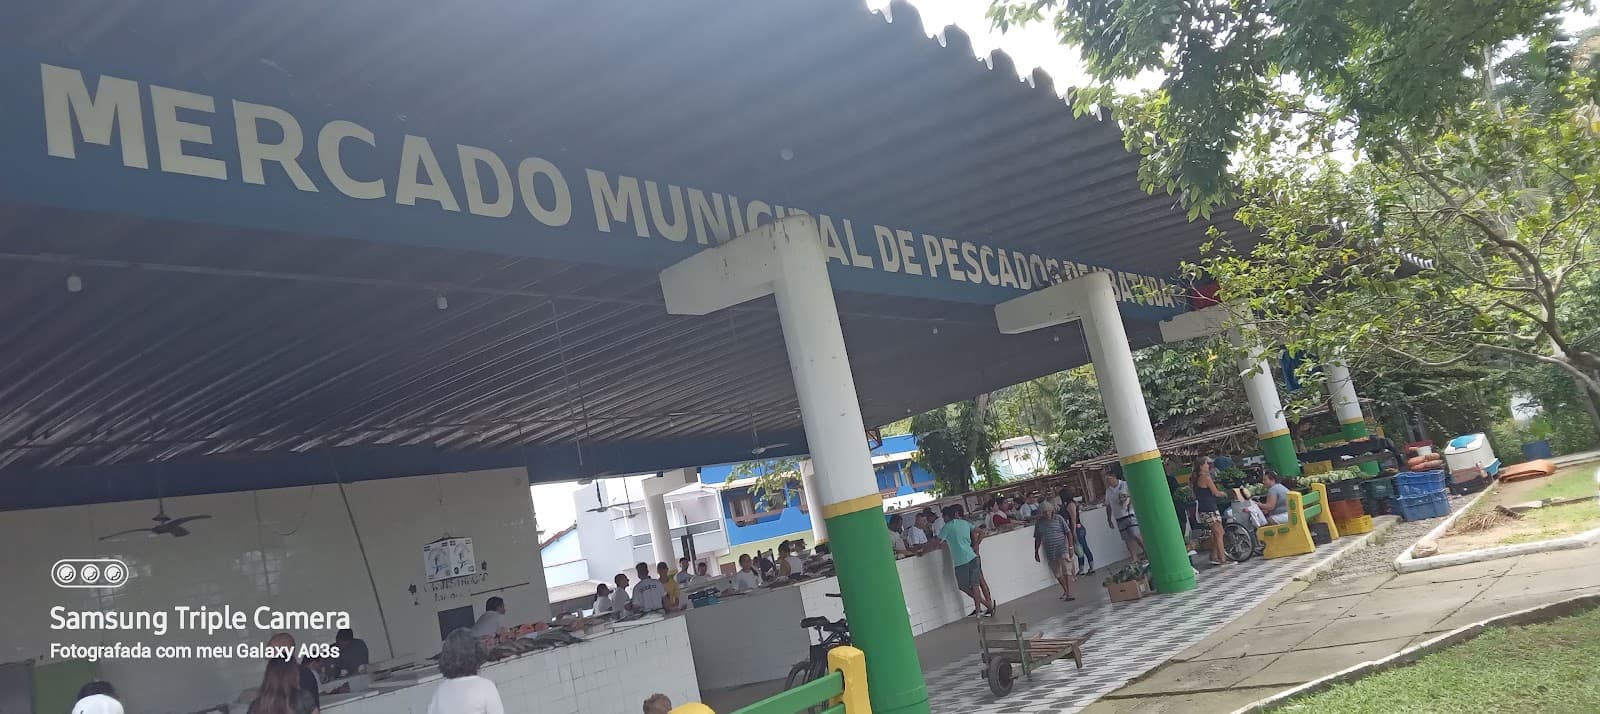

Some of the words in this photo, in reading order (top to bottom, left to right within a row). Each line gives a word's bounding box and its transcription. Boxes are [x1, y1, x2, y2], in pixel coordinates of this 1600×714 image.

[41, 63, 573, 227] MERCADO
[585, 168, 874, 269] MUNICAL
[873, 224, 923, 276] DE
[922, 234, 1062, 291] PESCADOS
[1092, 265, 1176, 308] BATUBA
